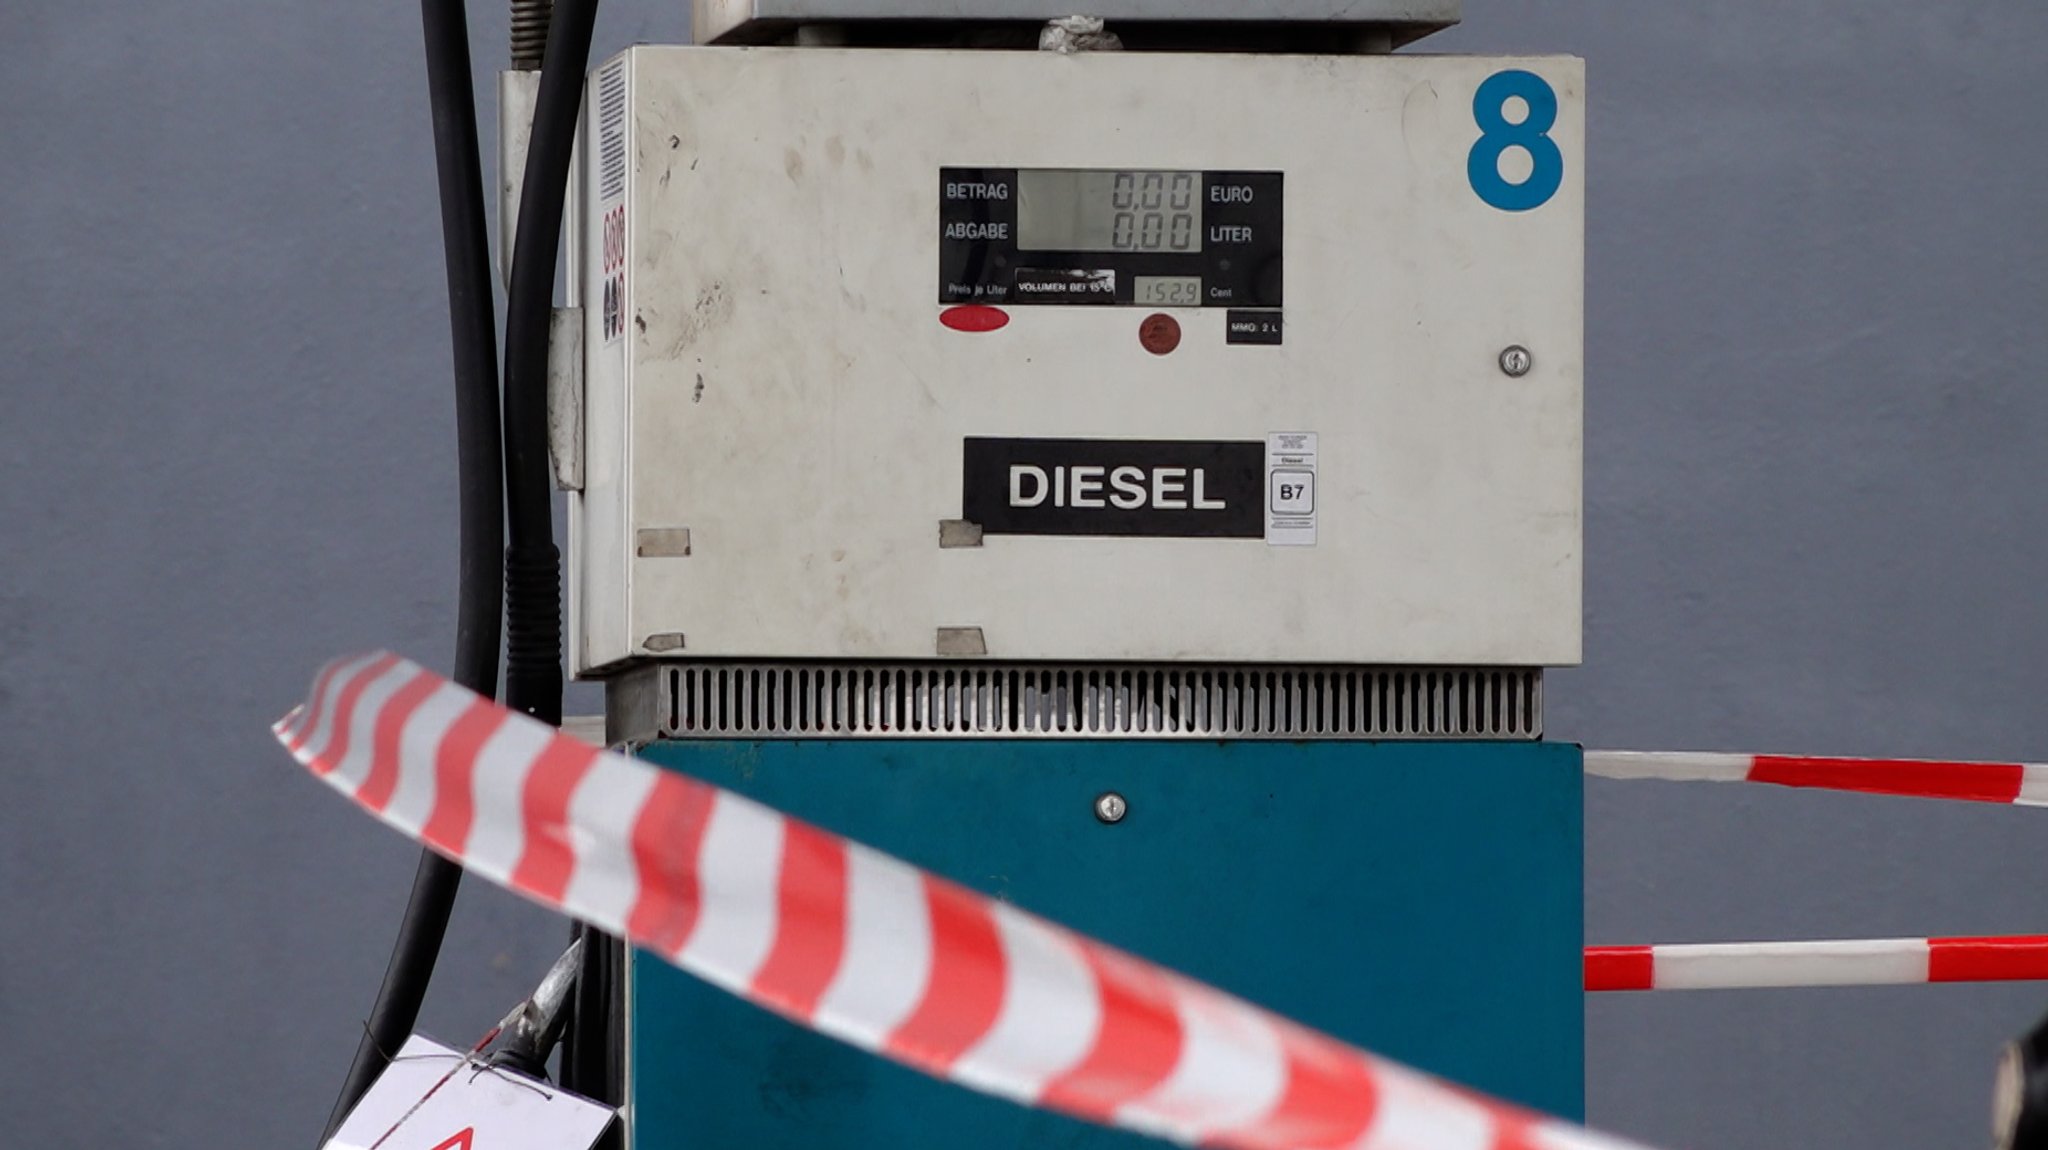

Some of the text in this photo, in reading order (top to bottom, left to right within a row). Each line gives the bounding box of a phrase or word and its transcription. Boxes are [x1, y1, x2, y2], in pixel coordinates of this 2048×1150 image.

[1467, 68, 1563, 212] 8
[946, 183, 1008, 200] BETRAG
[1112, 172, 1193, 211] 0,00
[1210, 186, 1253, 203] EURO
[945, 223, 1008, 240] ABGABE
[1112, 212, 1193, 250] 0,00
[1210, 226, 1252, 242] LITER
[948, 283, 1008, 296] Preis je Liter
[1018, 282, 1067, 293] VOLUMEN
[1069, 282, 1086, 293] BEI
[1210, 287, 1232, 298] Cent
[1261, 322, 1269, 333] 2
[1271, 322, 1279, 333] L
[1009, 465, 1226, 510] DIESEL
[1280, 484, 1304, 500] B7
